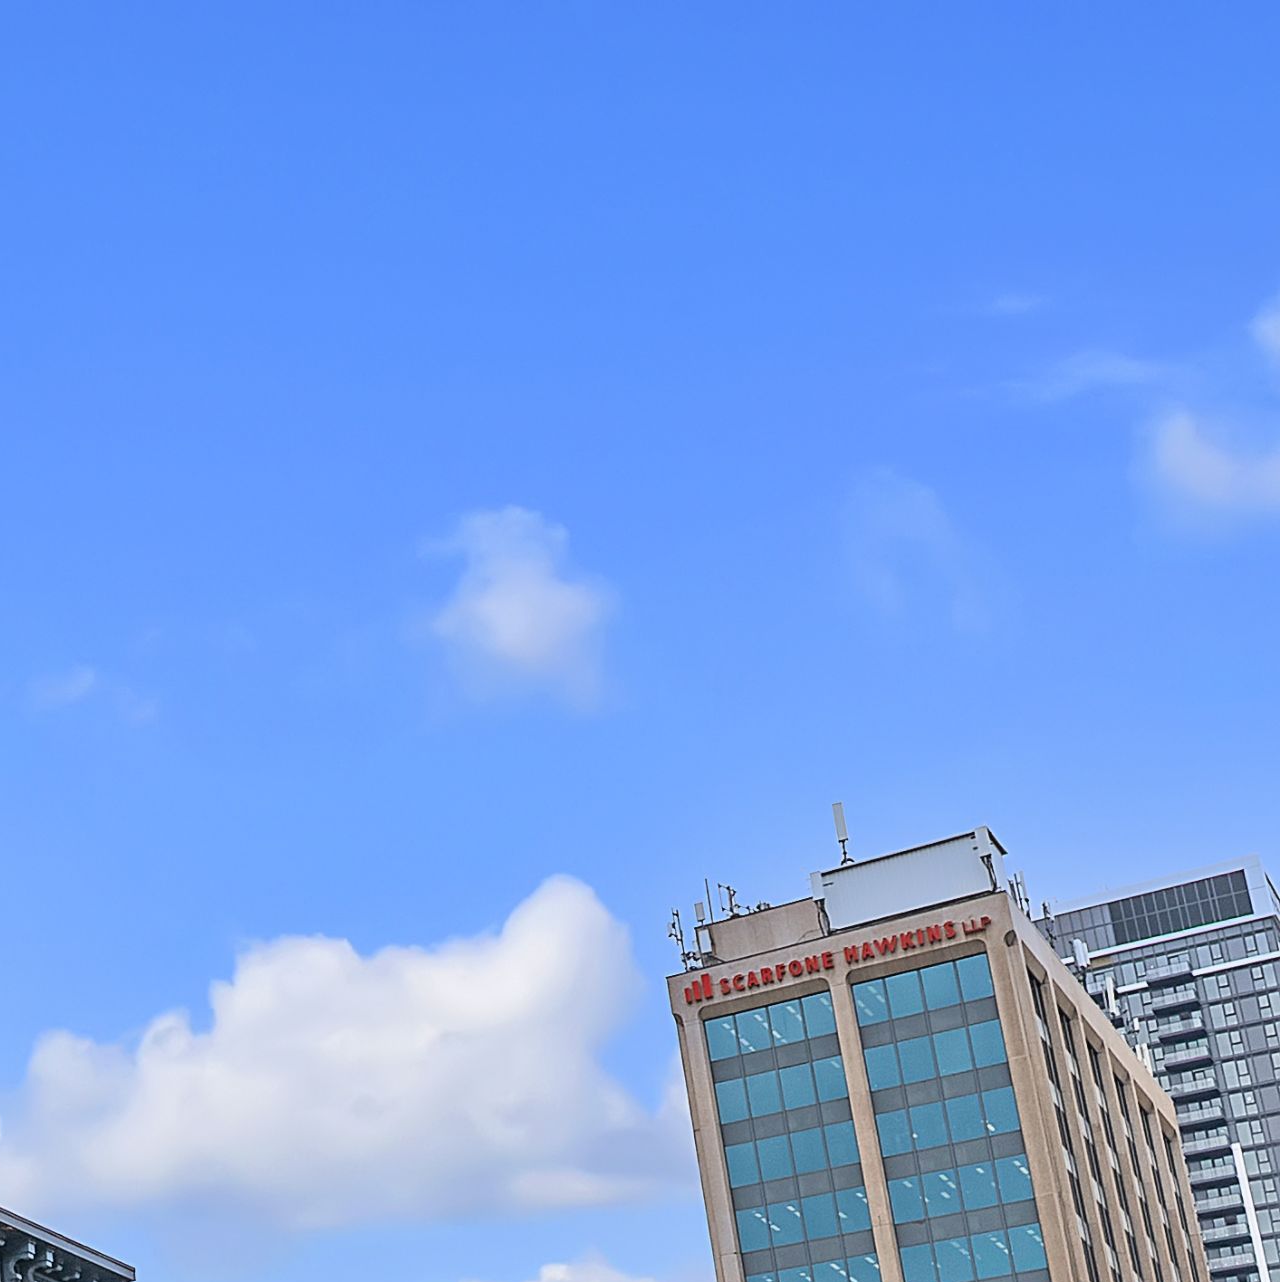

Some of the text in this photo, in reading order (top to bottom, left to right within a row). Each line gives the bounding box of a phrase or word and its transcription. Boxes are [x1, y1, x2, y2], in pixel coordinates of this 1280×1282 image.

[719, 915, 992, 995] SCARFONE HAWKINS LLP
